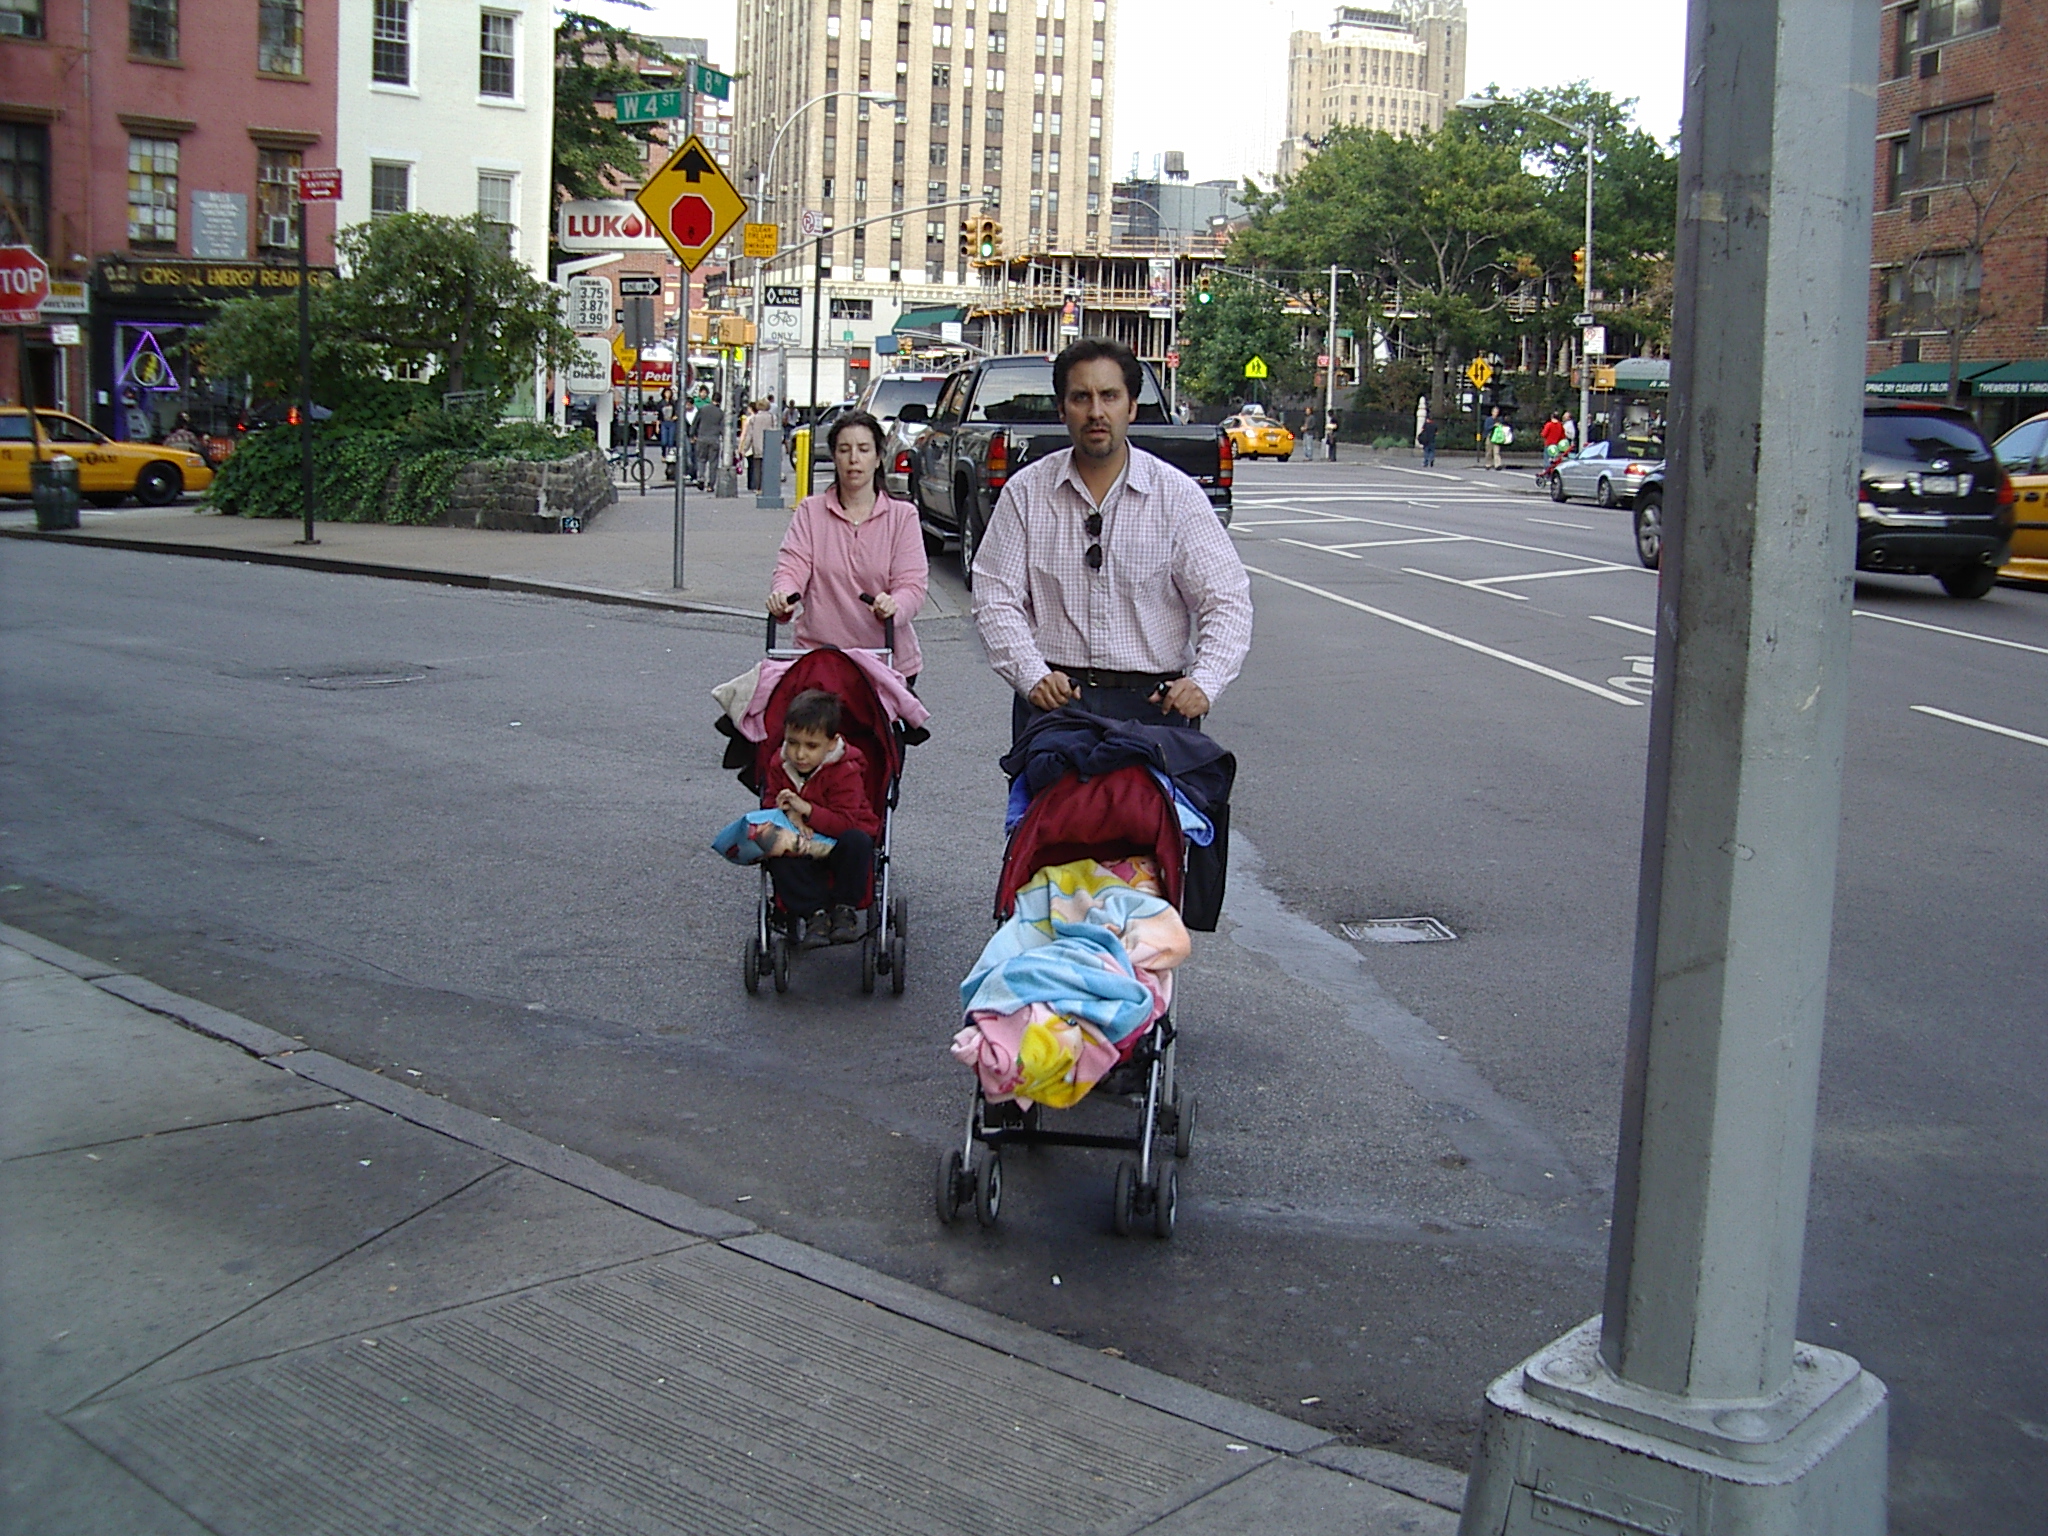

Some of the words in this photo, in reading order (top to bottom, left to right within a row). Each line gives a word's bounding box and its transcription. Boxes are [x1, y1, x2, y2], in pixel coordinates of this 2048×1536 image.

[704, 71, 712, 93] 8
[624, 97, 639, 119] W
[644, 95, 658, 117] 4
[662, 94, 675, 107] ST
[305, 180, 336, 188] ANYTIME
[0, 267, 44, 294] TOP
[141, 267, 205, 286] CRYSL
[207, 268, 256, 287] ENERGY
[261, 269, 318, 288] READIG
[580, 287, 604, 298] 3.75
[642, 283, 655, 291] WAY
[777, 288, 799, 297] BIKE
[580, 300, 604, 311] 3.87
[580, 313, 603, 324] 3.99
[771, 331, 794, 341] ONLY
[573, 370, 605, 380] Diesel
[1884, 383, 1895, 393] DRY
[1895, 383, 1923, 393] CLEANERS
[1979, 383, 2020, 394] TYPEWRITERS
